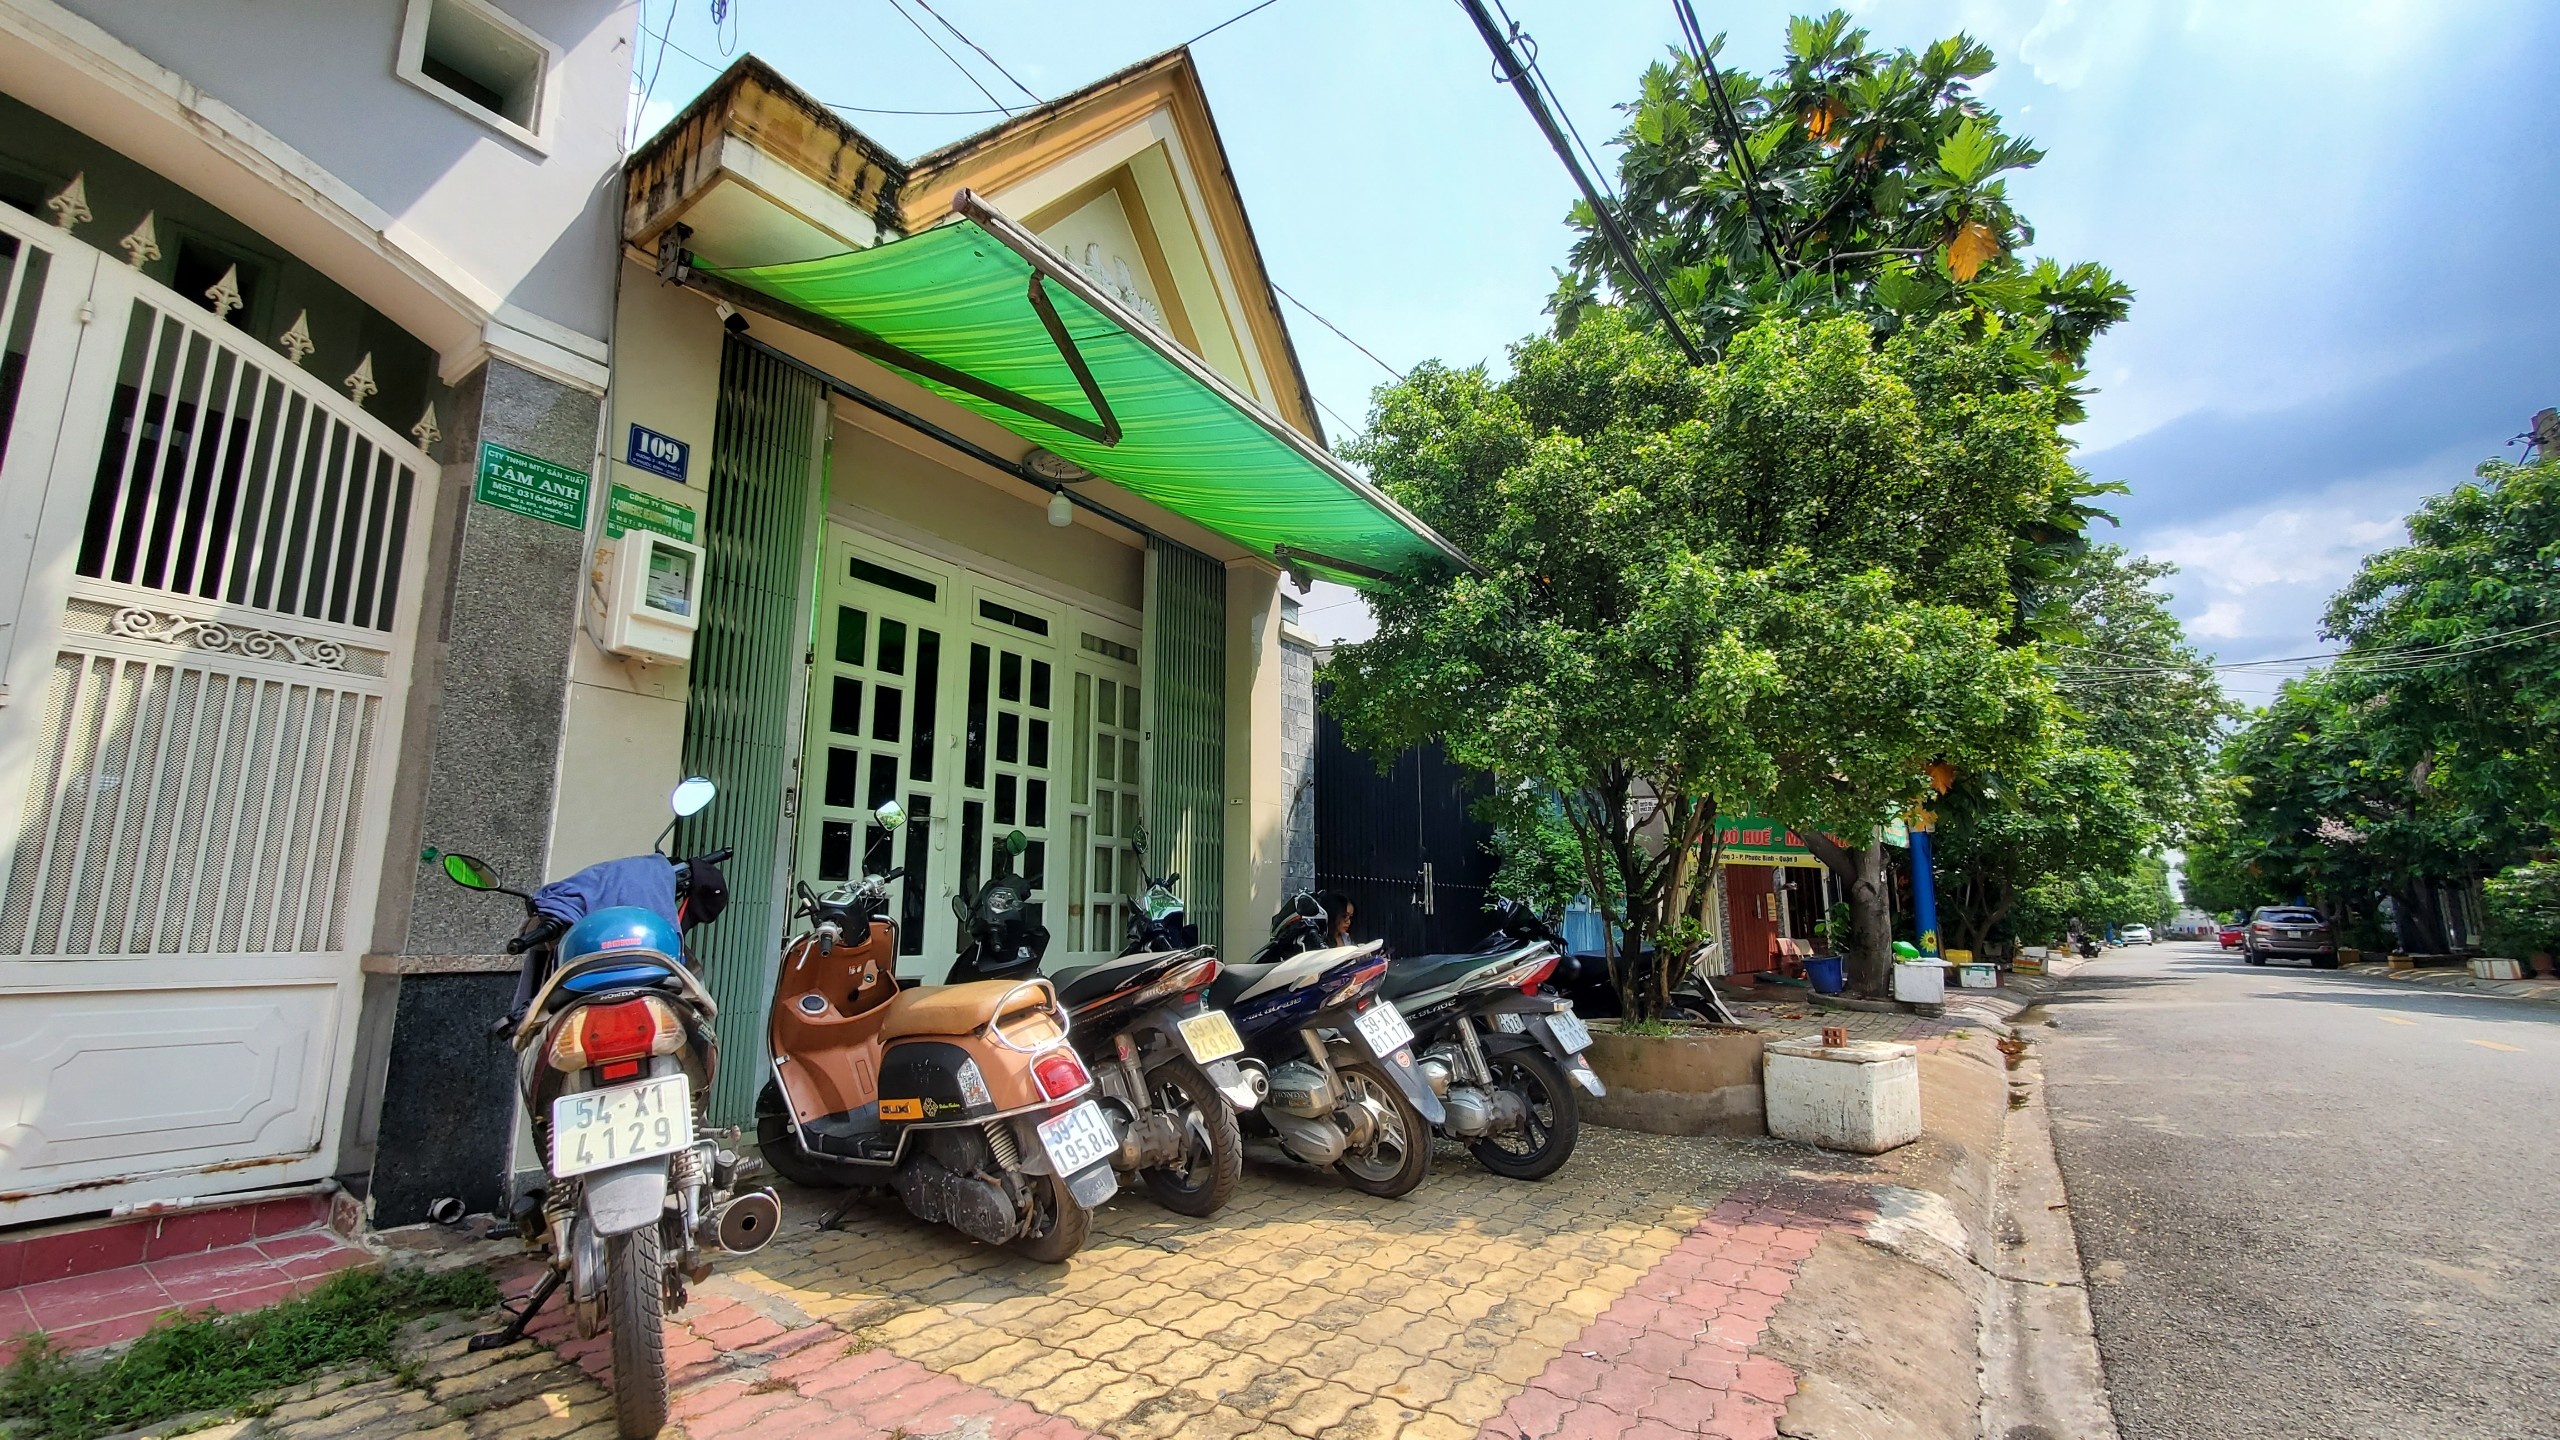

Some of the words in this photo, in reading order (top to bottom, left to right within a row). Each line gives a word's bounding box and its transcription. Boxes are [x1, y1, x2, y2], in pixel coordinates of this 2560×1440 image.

[638, 431, 680, 464] 109
[488, 450, 505, 461] CTY
[506, 455, 528, 468] TNHH
[529, 462, 546, 473] MTV
[546, 468, 563, 479] SẢN
[564, 474, 585, 486] XUẤT
[489, 463, 535, 487] TÂM
[538, 480, 581, 501] ANH
[492, 482, 515, 495] MST:
[517, 489, 574, 511] 0316469951
[629, 493, 650, 505] CÔNG
[651, 500, 660, 508] TY
[661, 504, 680, 516] TNHH
[1742, 826, 1773, 846] HUẾ
[600, 990, 636, 1001] HONDA
[1186, 1016, 1224, 1040] 59-X1
[1361, 1007, 1395, 1035] 59-X1
[1371, 1021, 1410, 1054] 811.17
[1192, 1032, 1239, 1060] 249.90
[576, 1084, 666, 1129] 54-X1
[576, 1116, 672, 1164] 4129
[1047, 1108, 1095, 1145] 59-L1
[1054, 1127, 1113, 1172] 195.84
